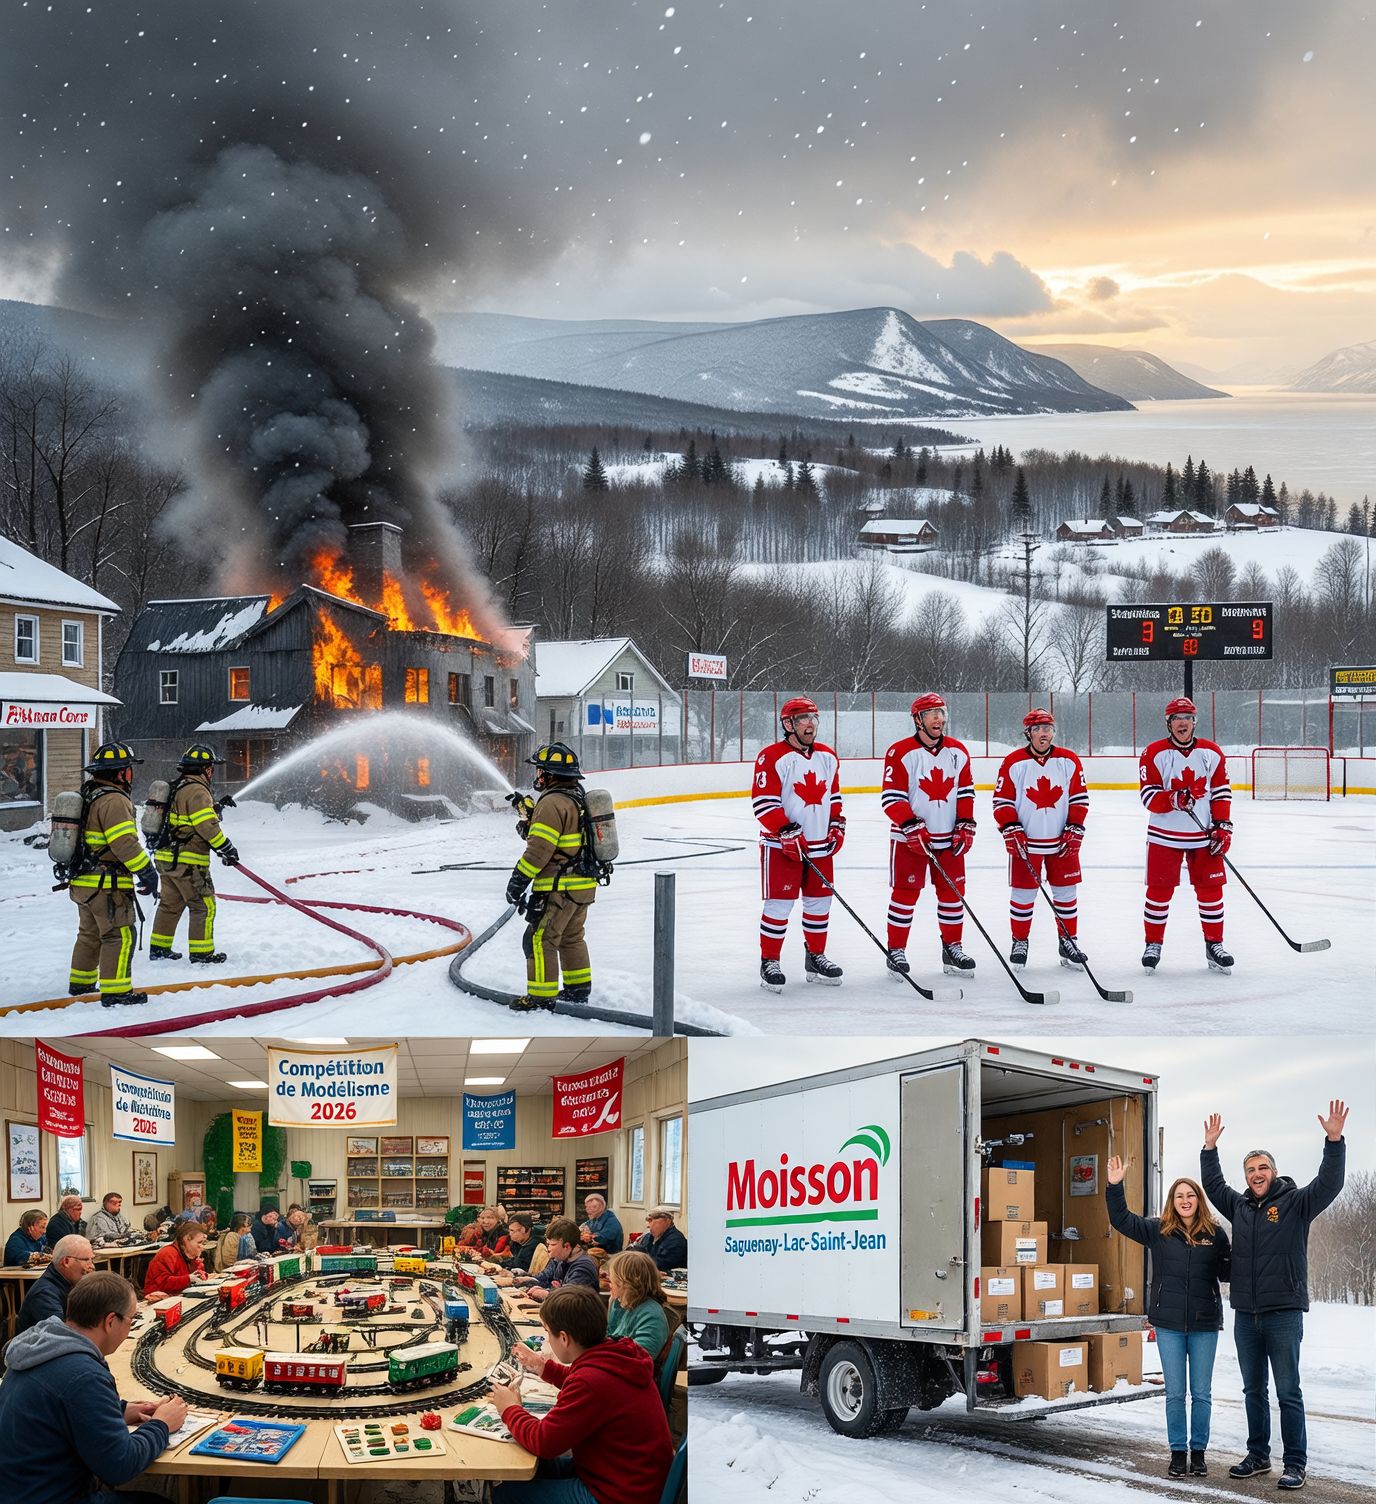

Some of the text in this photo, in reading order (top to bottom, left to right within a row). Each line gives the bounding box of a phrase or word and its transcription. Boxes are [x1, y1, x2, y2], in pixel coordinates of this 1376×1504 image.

[278, 1059, 384, 1080] Compétition
[276, 1080, 390, 1097] de Modélisme
[310, 1101, 357, 1120] 2026
[726, 1152, 879, 1211] Moisson
[724, 1229, 886, 1257] Saguenay-Lac-Saint-Jean
